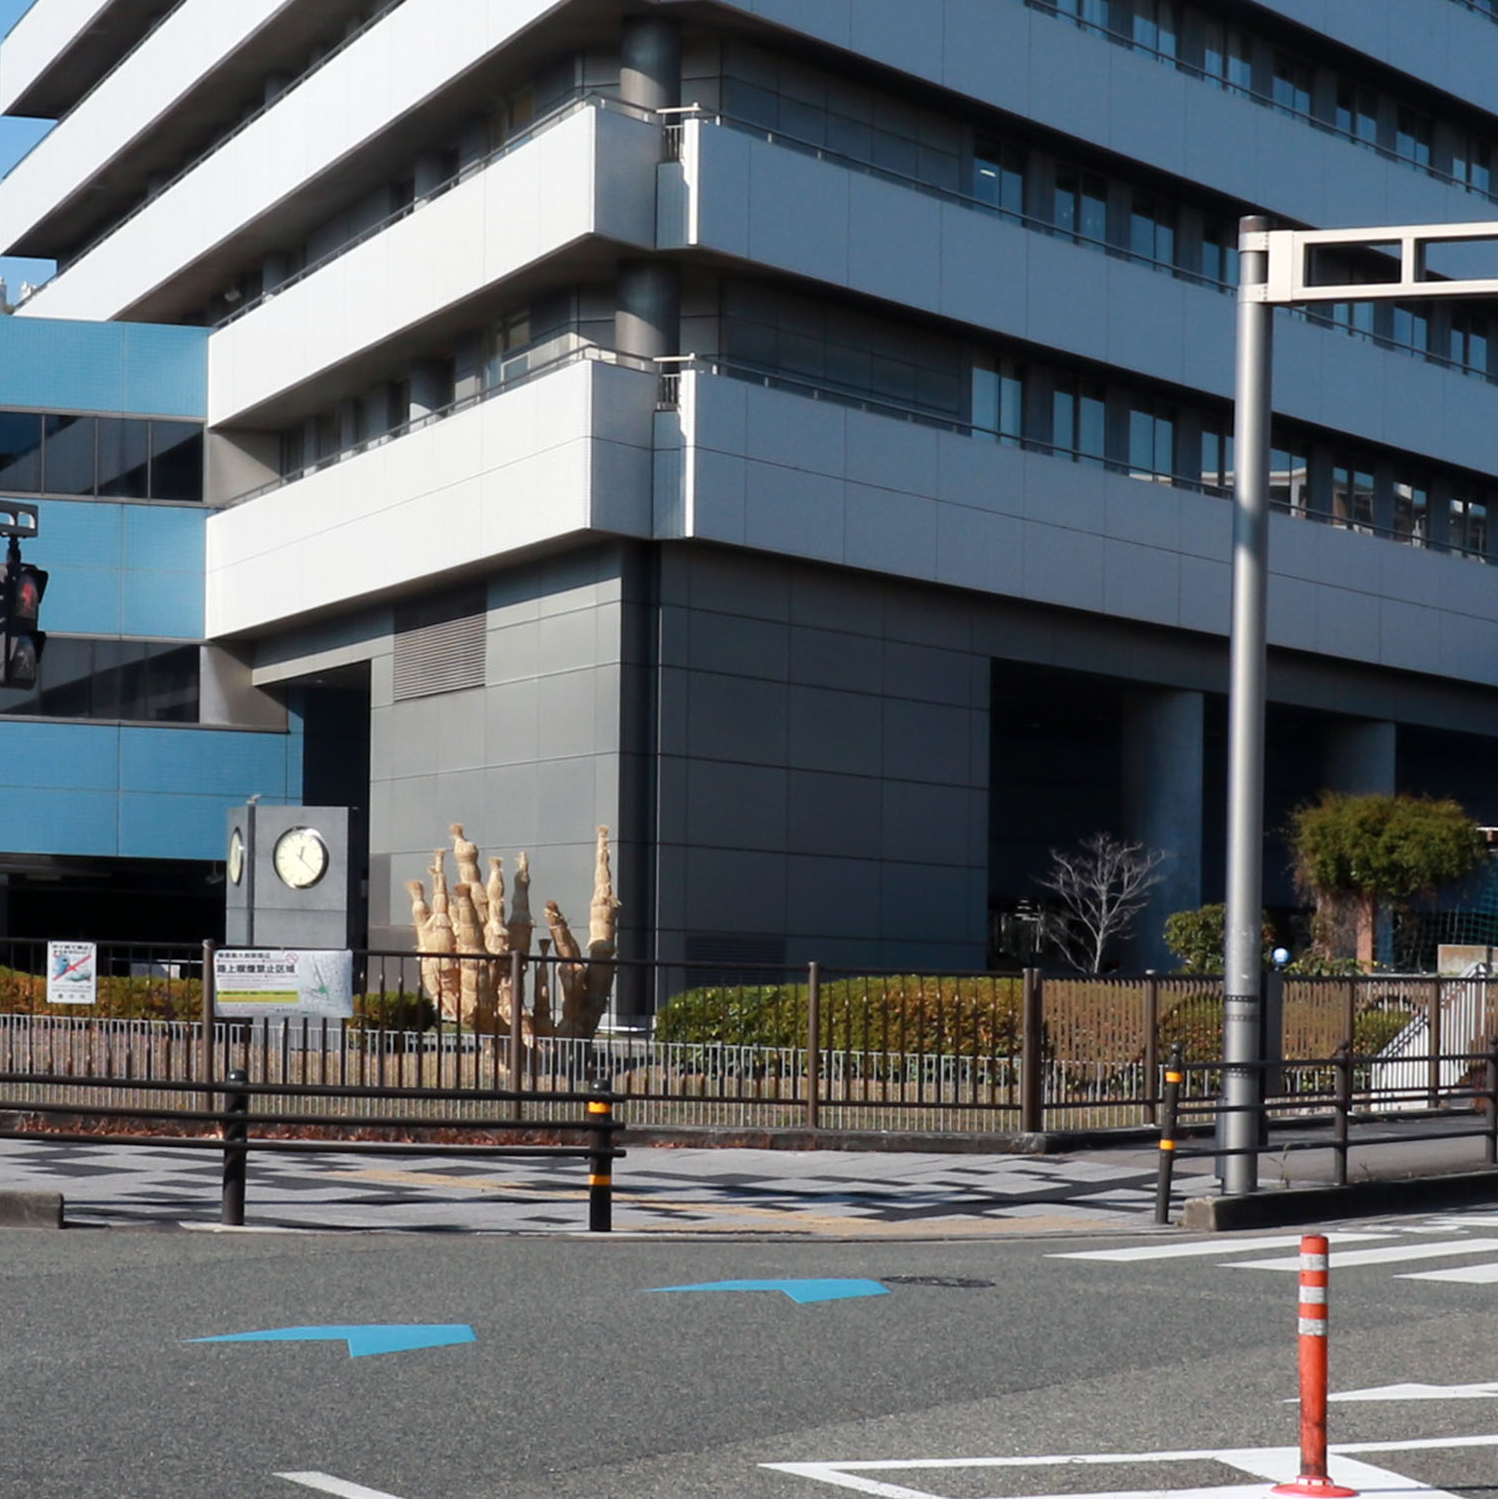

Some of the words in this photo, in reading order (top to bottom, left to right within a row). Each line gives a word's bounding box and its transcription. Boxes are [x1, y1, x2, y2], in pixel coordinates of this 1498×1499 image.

[217, 964, 295, 974] 路上喫煙禁止区域
